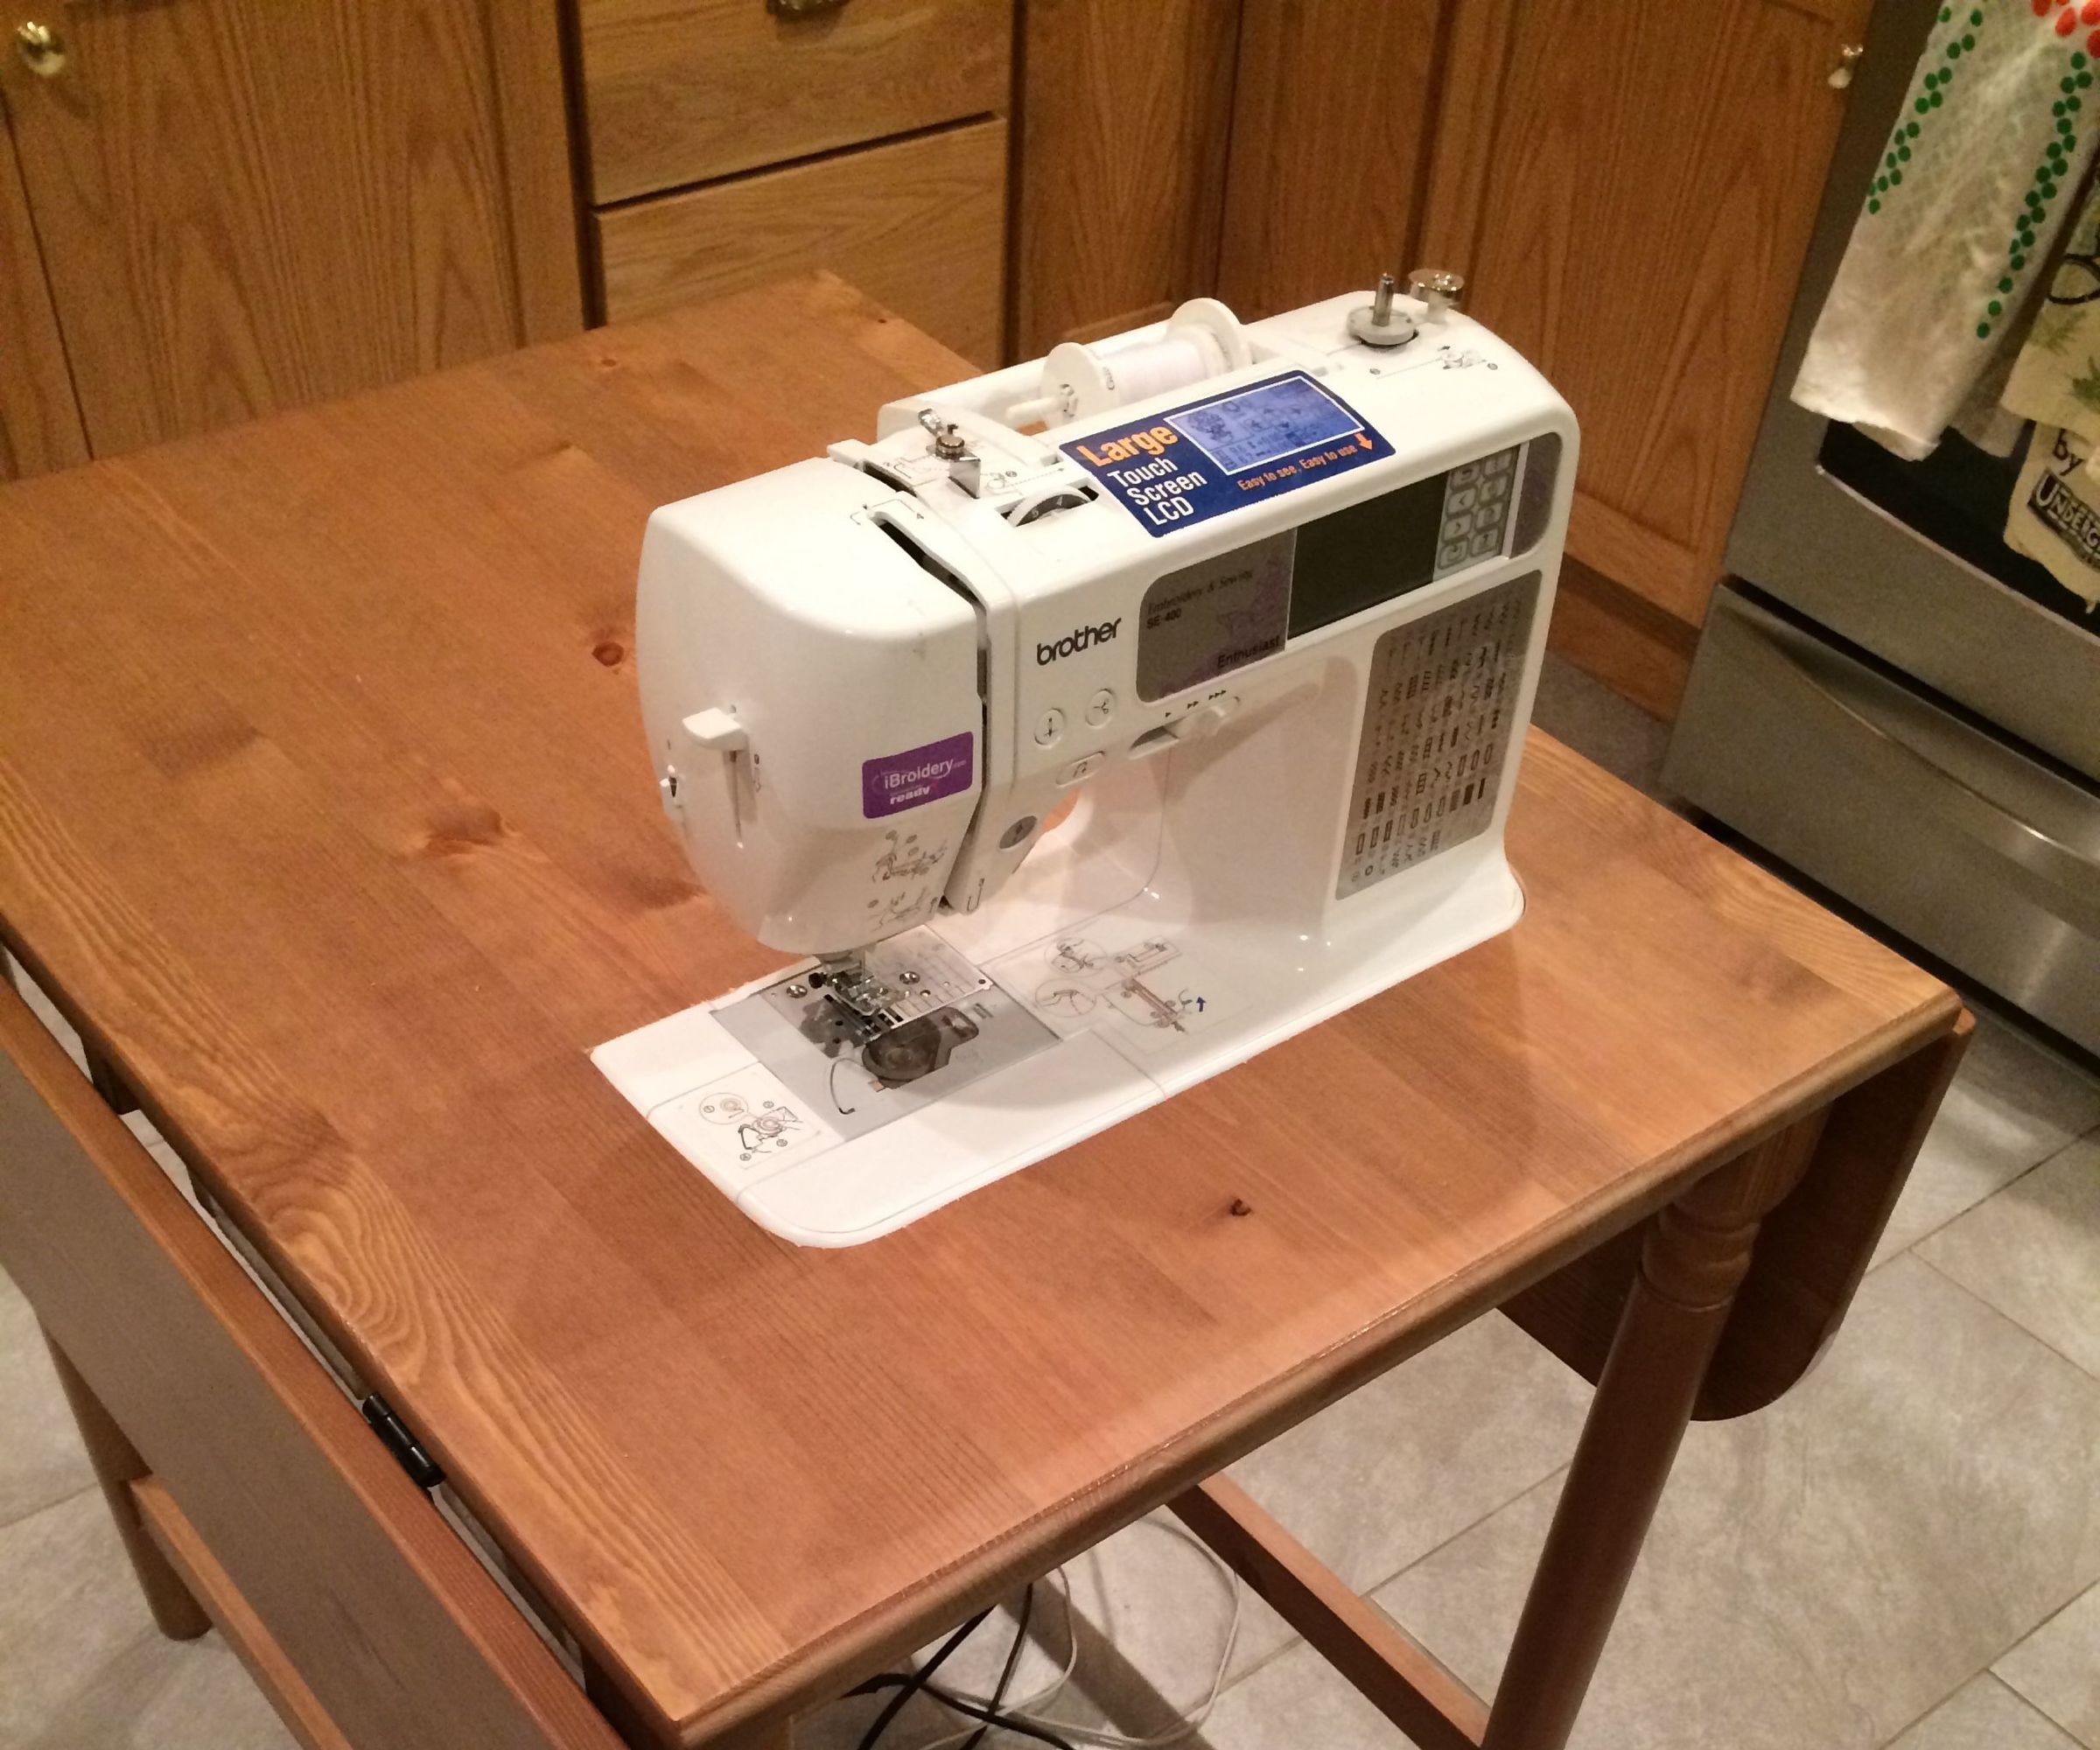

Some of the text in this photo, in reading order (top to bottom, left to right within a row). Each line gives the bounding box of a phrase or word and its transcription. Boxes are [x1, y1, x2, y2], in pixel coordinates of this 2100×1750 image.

[1076, 425, 1178, 466] Large
[2053, 428, 2084, 476] by
[1107, 458, 1178, 487] Touch
[1237, 476, 1265, 491] Easy
[1265, 471, 1277, 484] to
[1299, 454, 1326, 470] Easy
[1326, 449, 1338, 462] to
[1339, 444, 1359, 458] use
[1127, 470, 1208, 506] Screen
[1144, 496, 1194, 526] LCD
[1037, 618, 1121, 666] brother
[1217, 635, 1280, 668] Enthusiast
[890, 786, 930, 804] ready
